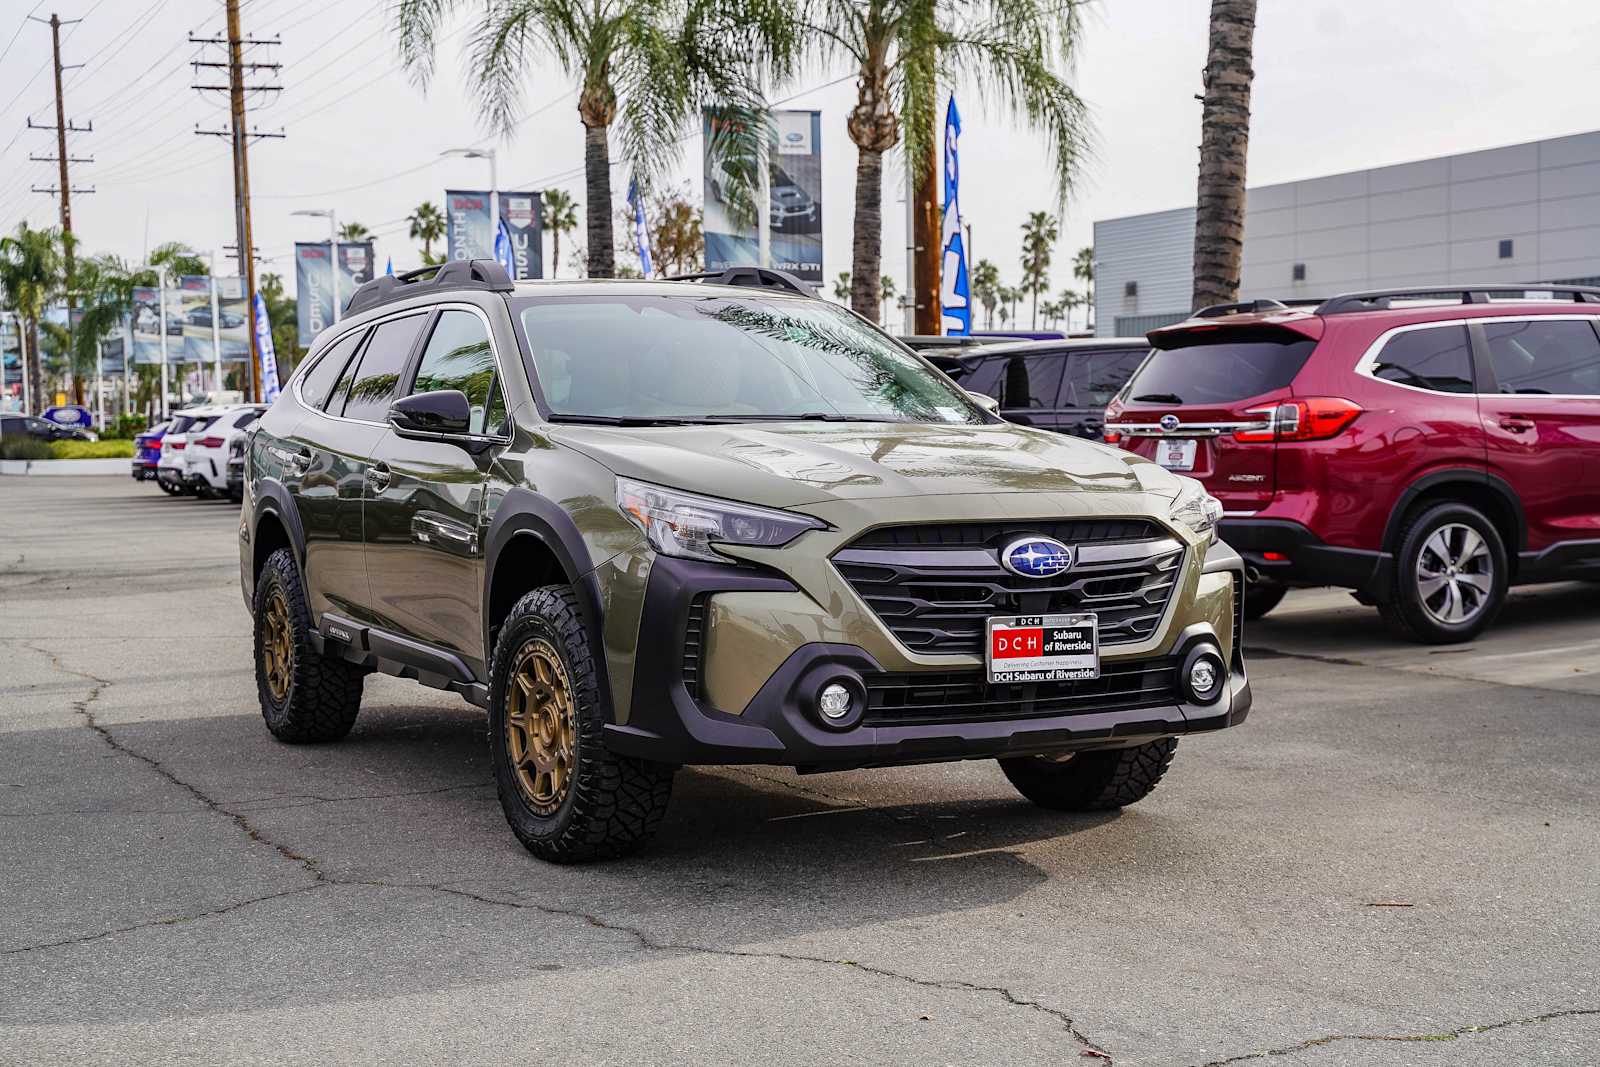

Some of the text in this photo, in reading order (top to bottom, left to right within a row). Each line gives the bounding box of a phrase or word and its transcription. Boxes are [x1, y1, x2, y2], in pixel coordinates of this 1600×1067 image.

[800, 262, 821, 271] STI
[1228, 474, 1266, 482] ASCENT
[1053, 630, 1082, 640] Subaru
[1044, 640, 1092, 652] of Riverside
[994, 668, 1095, 681] DCH Subaru of Riverside
